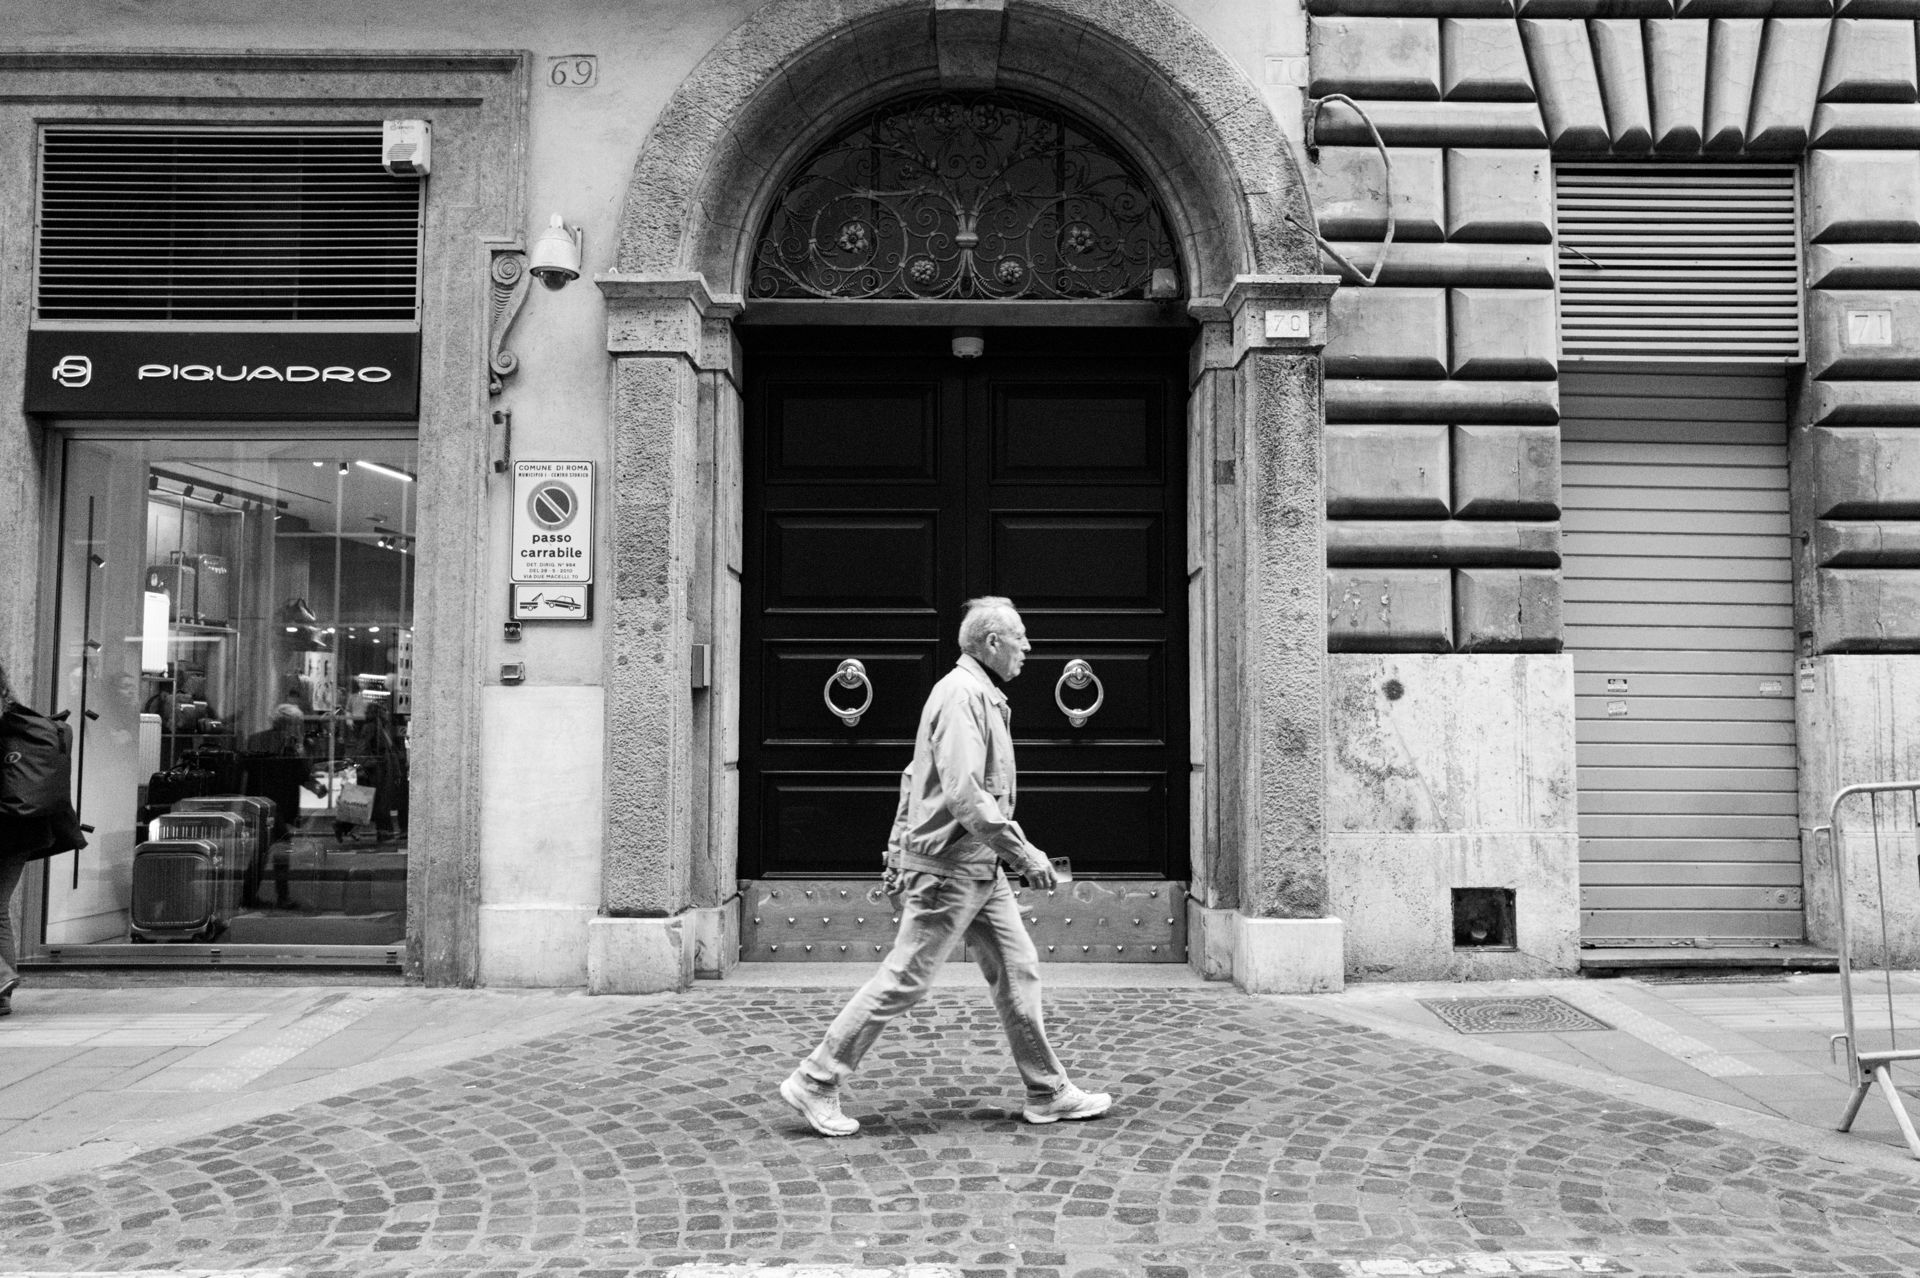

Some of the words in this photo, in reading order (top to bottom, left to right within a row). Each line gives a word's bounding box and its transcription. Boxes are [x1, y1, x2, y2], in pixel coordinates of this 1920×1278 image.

[551, 60, 592, 85] 69
[1273, 314, 1301, 331] 70
[1854, 314, 1883, 341] 71
[138, 364, 392, 383] PIQUADRO
[532, 534, 572, 544] passo
[520, 547, 582, 558] carrabile
